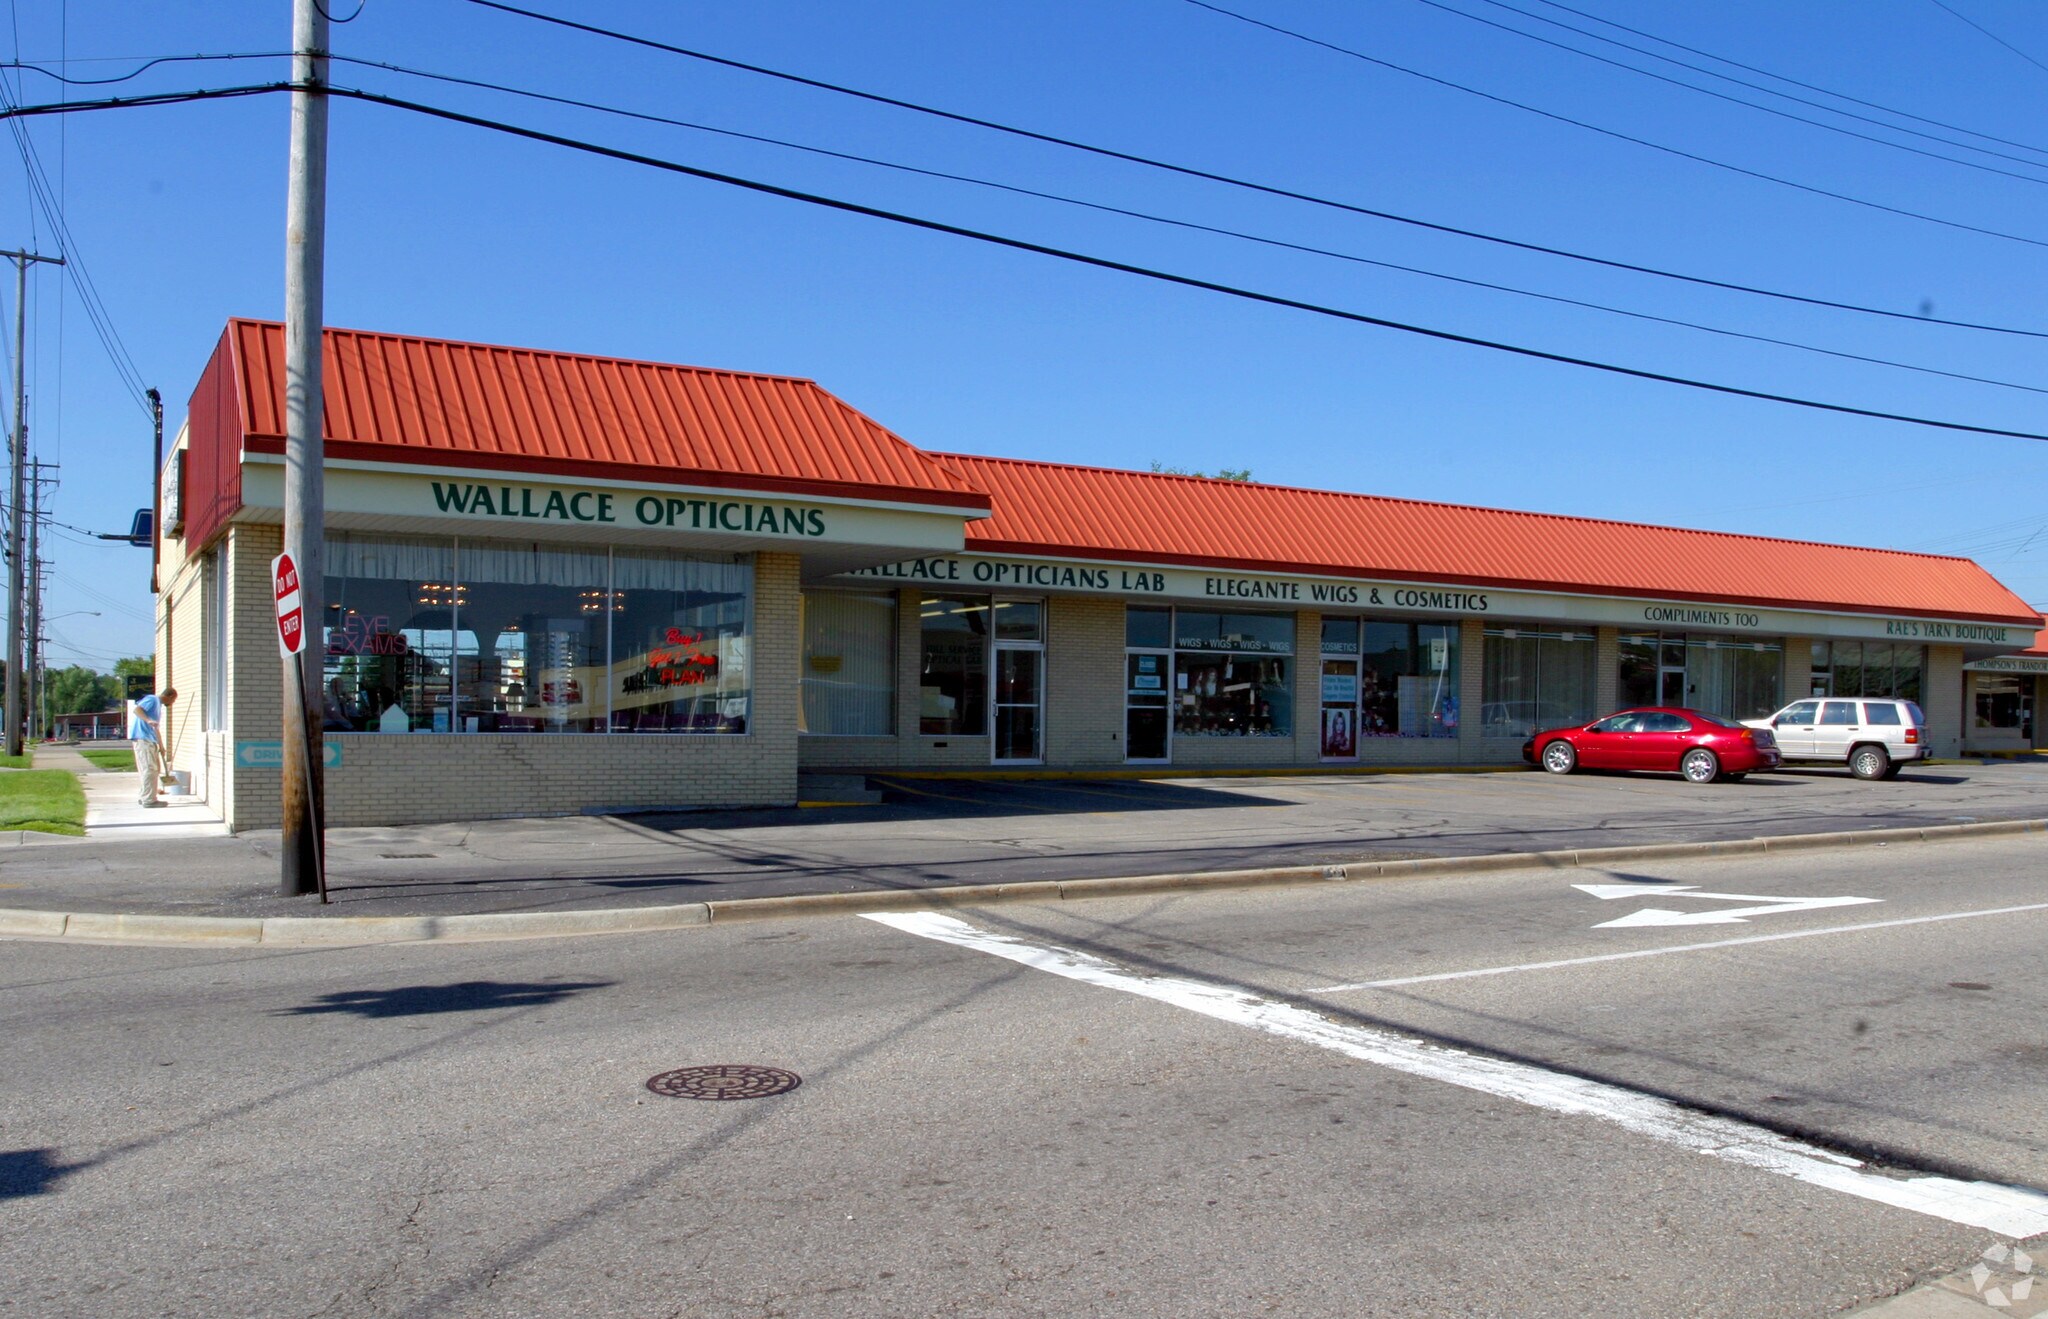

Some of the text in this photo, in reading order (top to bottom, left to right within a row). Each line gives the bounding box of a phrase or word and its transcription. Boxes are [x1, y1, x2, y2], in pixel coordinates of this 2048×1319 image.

[431, 482, 826, 537] WALLACE OPTICIANS
[277, 569, 296, 594] DO NOT
[849, 559, 1165, 592] LLACE OPTICIANS LAB
[1205, 577, 1489, 611] ELEGANTE WIGS & COSMETICS
[283, 615, 299, 636] ENTER
[344, 615, 389, 635] EYE
[1644, 606, 1759, 627] COMPLIMENTS TOO
[665, 627, 693, 648] Buy
[1886, 621, 2007, 643] RAE'S YARN BOUTIQUE
[328, 633, 408, 655] EXAMS
[1179, 638, 1290, 651] WIGS WIGS WIGS WIGS
[1321, 642, 1357, 652] COSMETICS
[1974, 659, 2017, 670] THOMPSON'S
[661, 668, 705, 687] PLAN
[253, 749, 283, 760] DRIV
